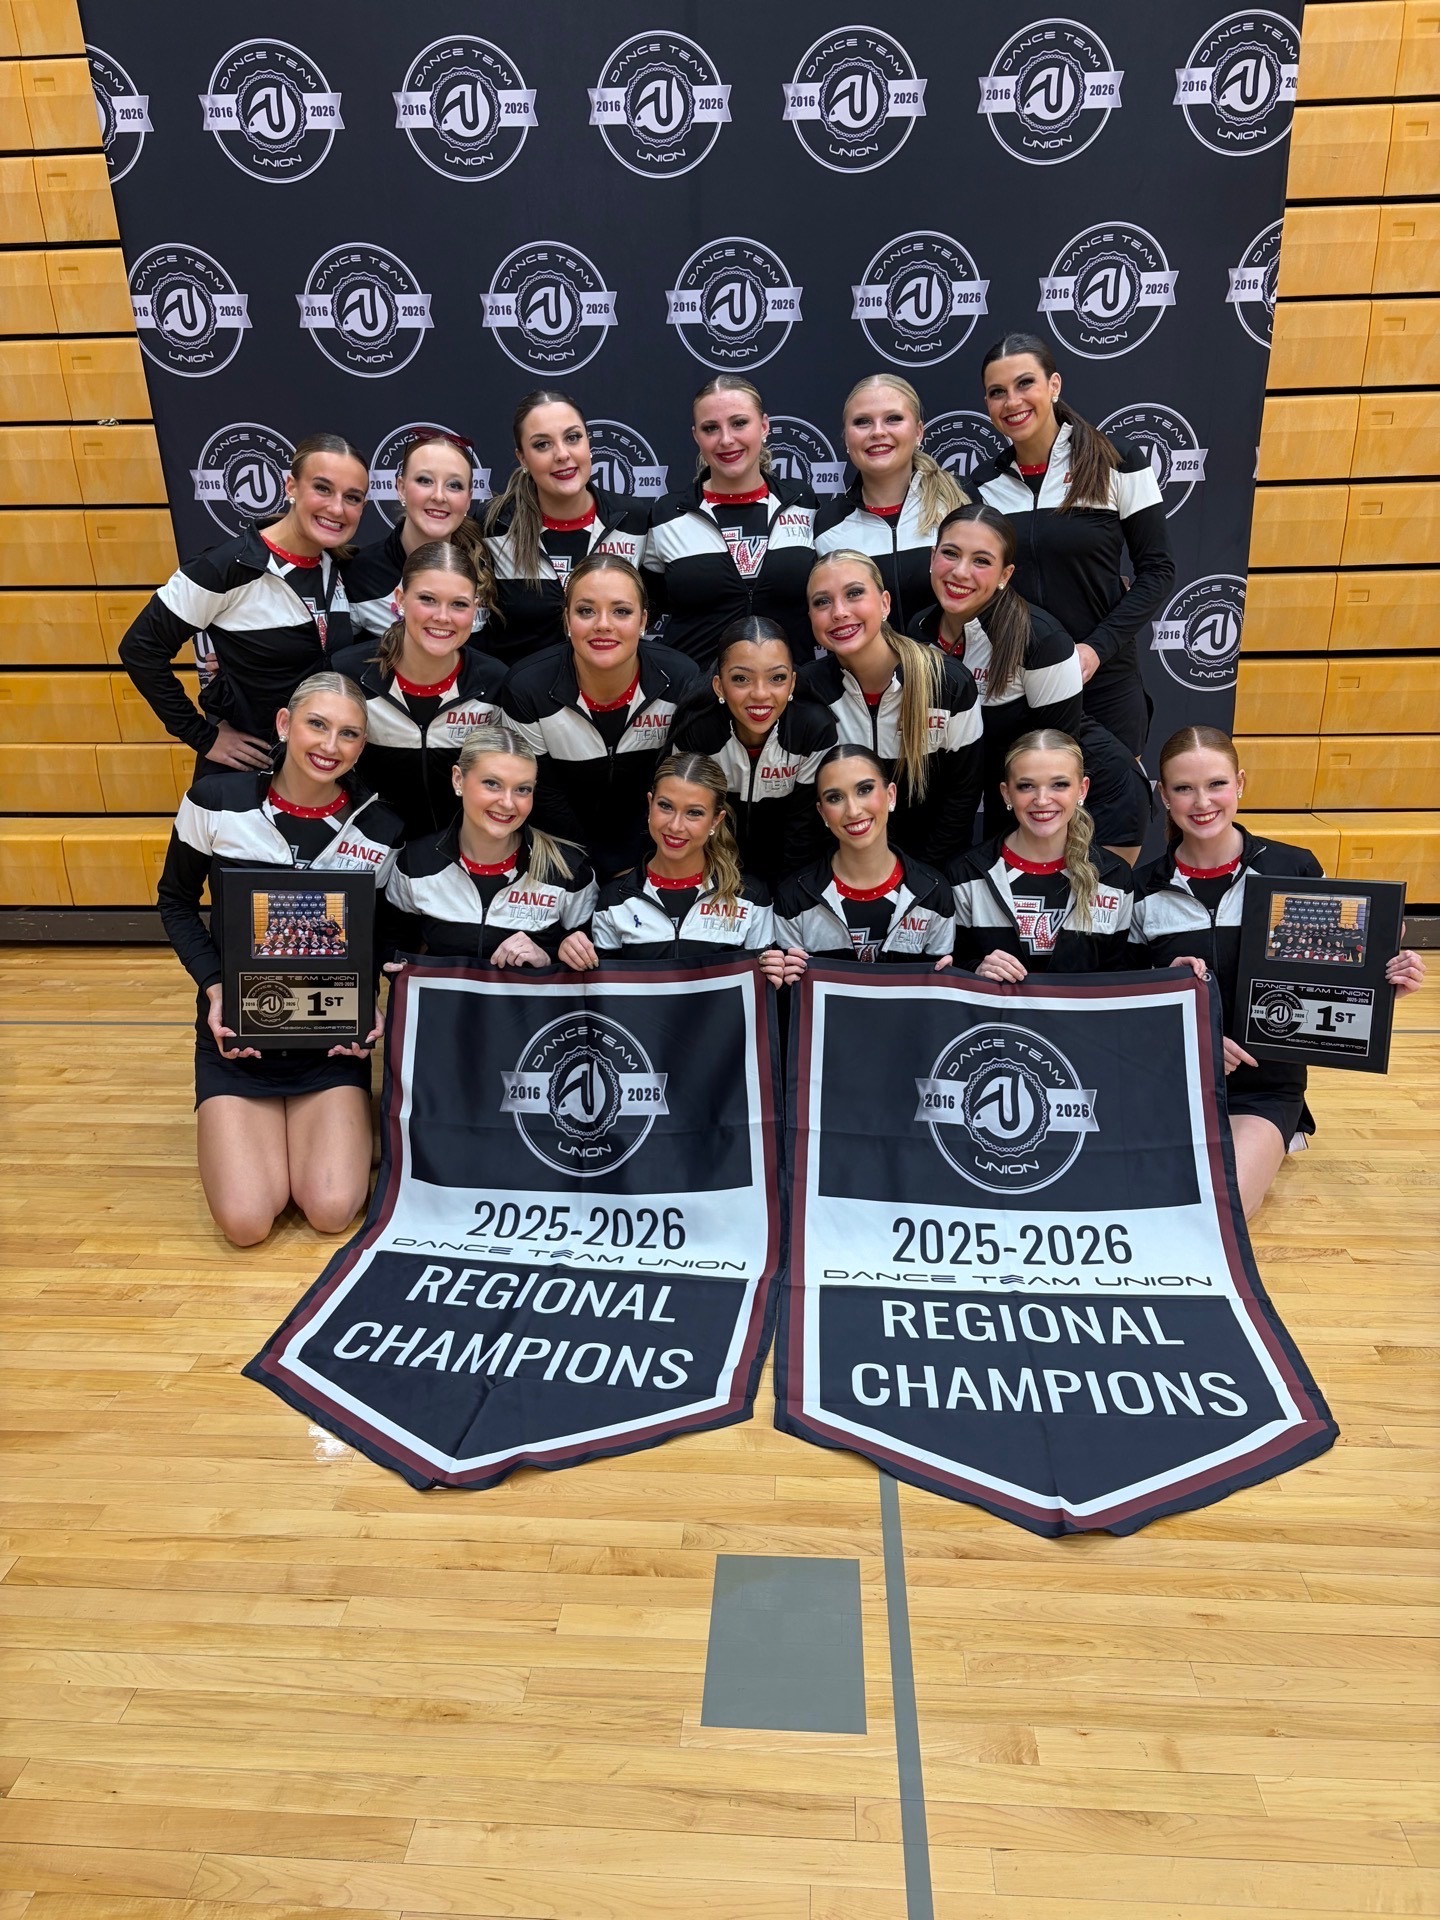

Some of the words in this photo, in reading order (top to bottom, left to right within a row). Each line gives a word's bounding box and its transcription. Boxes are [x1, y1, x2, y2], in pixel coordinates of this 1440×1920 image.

[1200, 23, 1254, 62] DANCE
[1262, 24, 1297, 59] TEAM
[806, 39, 857, 78] DANCE
[866, 40, 903, 75] TEAM
[1003, 31, 1055, 71] DANCE
[1064, 32, 1100, 67] TEAM
[220, 51, 267, 89] DANCE
[275, 53, 316, 88] TEAM
[415, 48, 464, 86] DANCE
[472, 50, 512, 85] TEAM
[610, 44, 660, 82] DANCE
[669, 45, 707, 81] TEAM
[986, 89, 1010, 100] 2016
[1090, 84, 1114, 96] 2026
[1182, 80, 1206, 92] 2016
[596, 100, 620, 112] 2016
[699, 98, 723, 109] 2026
[791, 96, 814, 107] 2016
[894, 92, 918, 104] 2026
[120, 108, 143, 120] 2026
[208, 107, 232, 118] 2016
[310, 106, 335, 116] 2026
[402, 104, 426, 115] 2016
[505, 102, 529, 114] 2026
[1217, 127, 1266, 140] UNION
[1023, 135, 1072, 148] UNION
[637, 149, 686, 162] UNION
[829, 143, 878, 156] UNION
[253, 155, 302, 167] UNION
[445, 153, 493, 165] UNION
[1062, 234, 1114, 272] DANCE
[1122, 235, 1156, 268] TEAM
[1252, 233, 1280, 262] DAN
[687, 249, 736, 286] DANCE
[744, 250, 780, 283] TEAM
[874, 243, 924, 280] DANCE
[932, 244, 967, 277] TEAM
[136, 255, 177, 290] DANCE
[185, 256, 224, 290] TEAM
[316, 255, 361, 290] DANCE
[369, 256, 408, 290] TEAM
[502, 253, 548, 288] DANCE
[556, 254, 593, 288] TEAM
[1046, 288, 1069, 299] 2016
[1145, 283, 1169, 294] 2026
[1234, 279, 1258, 290] 2016
[674, 302, 696, 312] 2016
[772, 299, 794, 310] 2026
[859, 297, 882, 307] 2016
[958, 292, 981, 303] 2026
[133, 306, 149, 317] 016
[220, 306, 242, 316] 2026
[305, 306, 328, 316] 2016
[402, 306, 425, 316] 2026
[489, 305, 512, 315] 2016
[586, 304, 609, 314] 2026
[1080, 331, 1127, 344] UNION
[711, 345, 758, 357] UNION
[895, 340, 942, 352] UNION
[169, 351, 214, 362] UNION
[347, 351, 393, 363] UNION
[528, 349, 575, 361] UNION
[970, 421, 1006, 451] TEAM
[1105, 414, 1146, 436] ANCE
[1153, 416, 1186, 446] TEAM
[209, 434, 250, 465] DANCE
[257, 435, 296, 464] TEAM
[611, 432, 646, 462] TEAM
[790, 428, 824, 458] TEAM
[1176, 460, 1199, 470] 2026
[199, 480, 220, 490] 2016
[370, 480, 392, 489] 2016
[474, 480, 485, 489] 26
[639, 477, 661, 486] 2026
[816, 473, 839, 482] 2026
[778, 513, 811, 527] DANCE
[597, 541, 636, 555] DANCE
[1174, 585, 1222, 616] DANCE
[1229, 585, 1247, 600] TE
[1158, 630, 1180, 640] 2016
[1190, 668, 1234, 678] UNION
[446, 711, 492, 725] DANCE
[632, 714, 674, 728] DANC
[447, 725, 474, 739] TEA
[760, 765, 800, 779] DANC
[336, 841, 387, 864] DANCE
[508, 890, 557, 908] DANCE
[508, 905, 550, 921] TEAM
[895, 930, 924, 945] EAM
[532, 1026, 587, 1069] DANCE
[592, 1029, 638, 1070] TEAM
[947, 1039, 1005, 1076] DANCE
[1015, 1042, 1065, 1085] TEAM
[508, 1085, 542, 1100] 2016
[628, 1088, 660, 1101] 2026
[923, 1092, 955, 1110] 2016
[1056, 1104, 1089, 1118] 2026
[558, 1142, 611, 1157] UNION
[975, 1156, 1039, 1174] UNION
[464, 1201, 685, 1254] 2025-2026
[893, 1217, 1132, 1265] 2025-2026
[392, 1238, 513, 1255] DANCE
[528, 1250, 624, 1263] TEAM
[638, 1258, 746, 1270] UNION
[824, 1270, 956, 1283] DANCE
[972, 1275, 1080, 1286] TEAM
[1095, 1276, 1212, 1286] UNION
[406, 1265, 675, 1322] REGIONAL
[882, 1300, 1184, 1344] REGIONAL
[334, 1322, 693, 1389] CHAMPIONS
[852, 1363, 1248, 1416] CHAMPIONS
